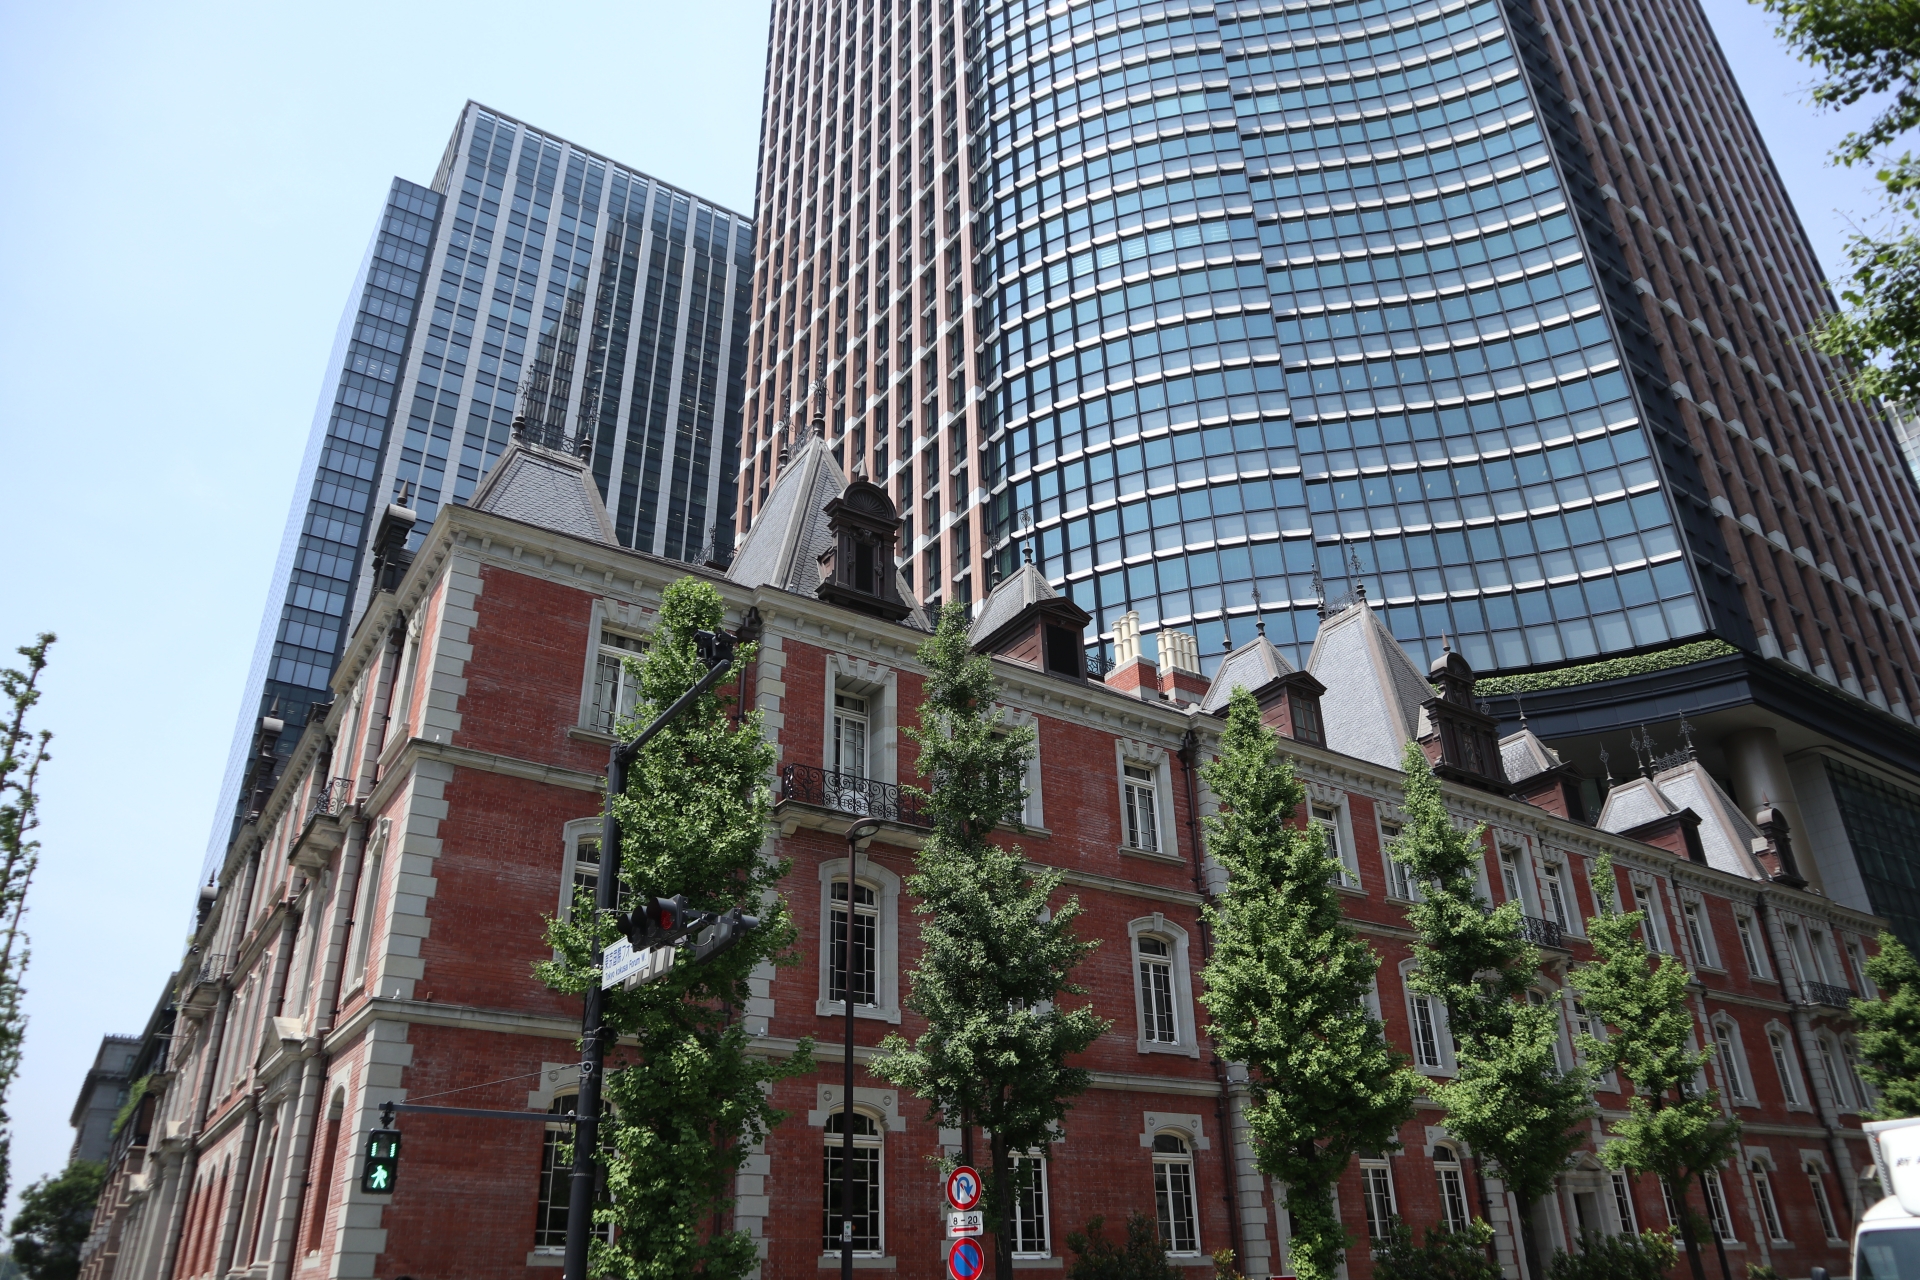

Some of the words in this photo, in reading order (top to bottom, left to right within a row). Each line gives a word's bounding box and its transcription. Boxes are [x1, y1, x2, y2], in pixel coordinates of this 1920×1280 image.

[604, 944, 633, 970] 東京国際フォ
[605, 971, 615, 981] Tokyo
[628, 957, 641, 969] Forum
